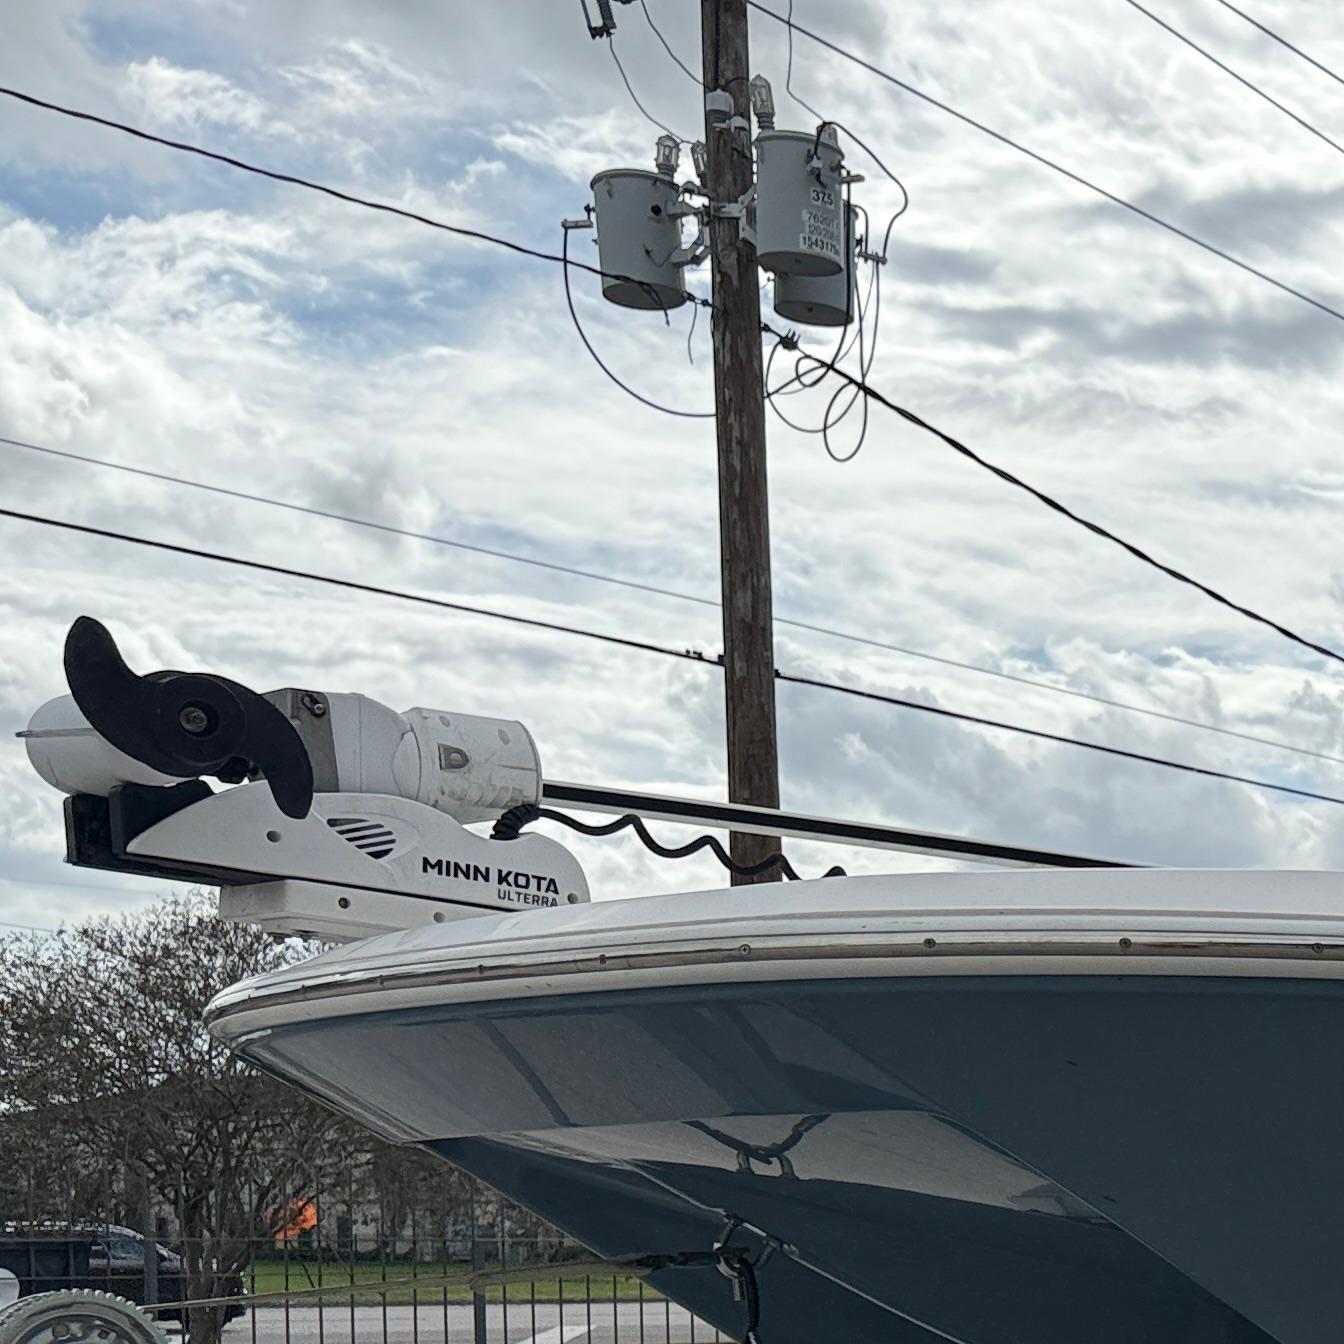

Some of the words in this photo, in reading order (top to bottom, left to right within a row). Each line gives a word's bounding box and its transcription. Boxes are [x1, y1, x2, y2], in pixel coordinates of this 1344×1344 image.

[422, 856, 491, 883] MINN
[497, 868, 560, 895] KOTA
[497, 888, 559, 907] ULTERRA
